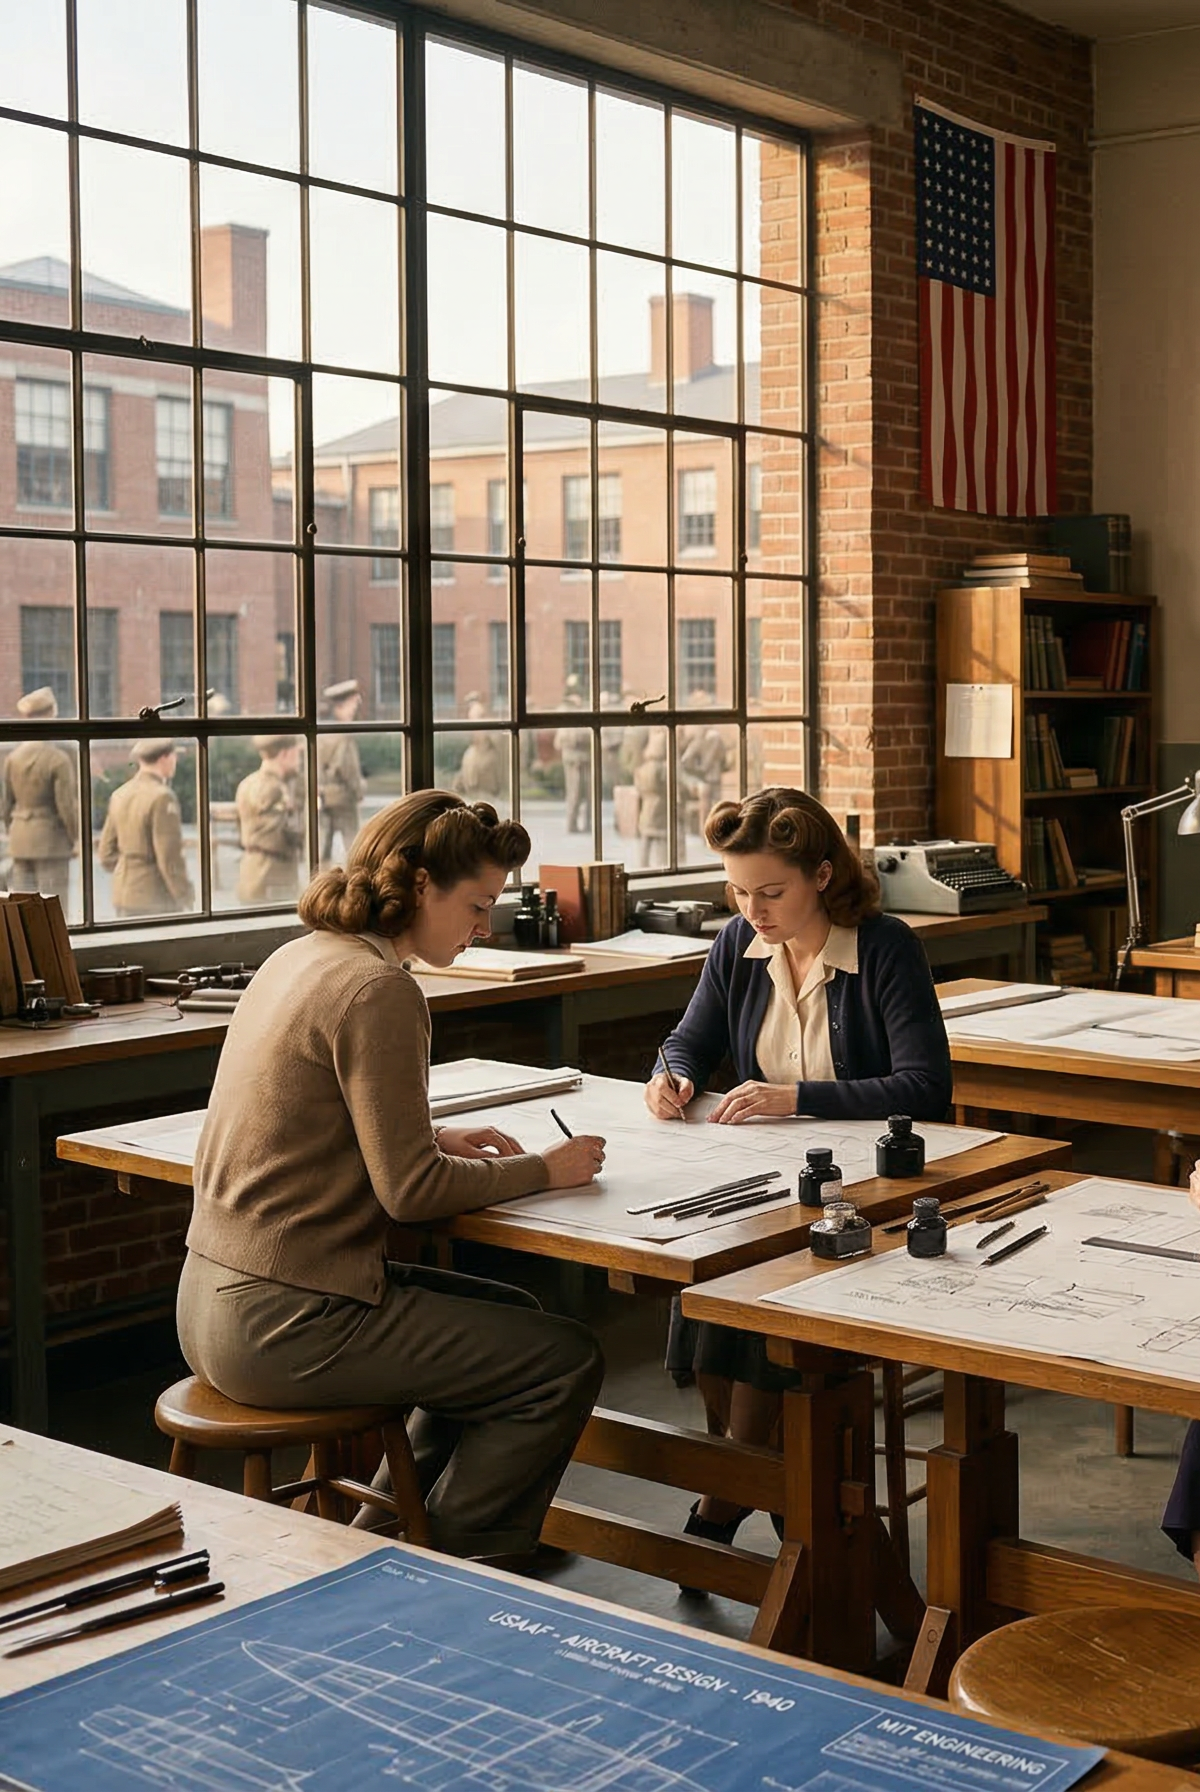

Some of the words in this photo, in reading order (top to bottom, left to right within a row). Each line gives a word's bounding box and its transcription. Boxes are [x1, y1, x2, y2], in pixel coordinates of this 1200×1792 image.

[488, 1610, 555, 1635] USAAF
[560, 1634, 657, 1667] AIRCRAFT
[652, 1662, 730, 1691] DESIGN
[876, 1718, 918, 1736] MIT
[912, 1728, 1047, 1776] ENGINEERING
